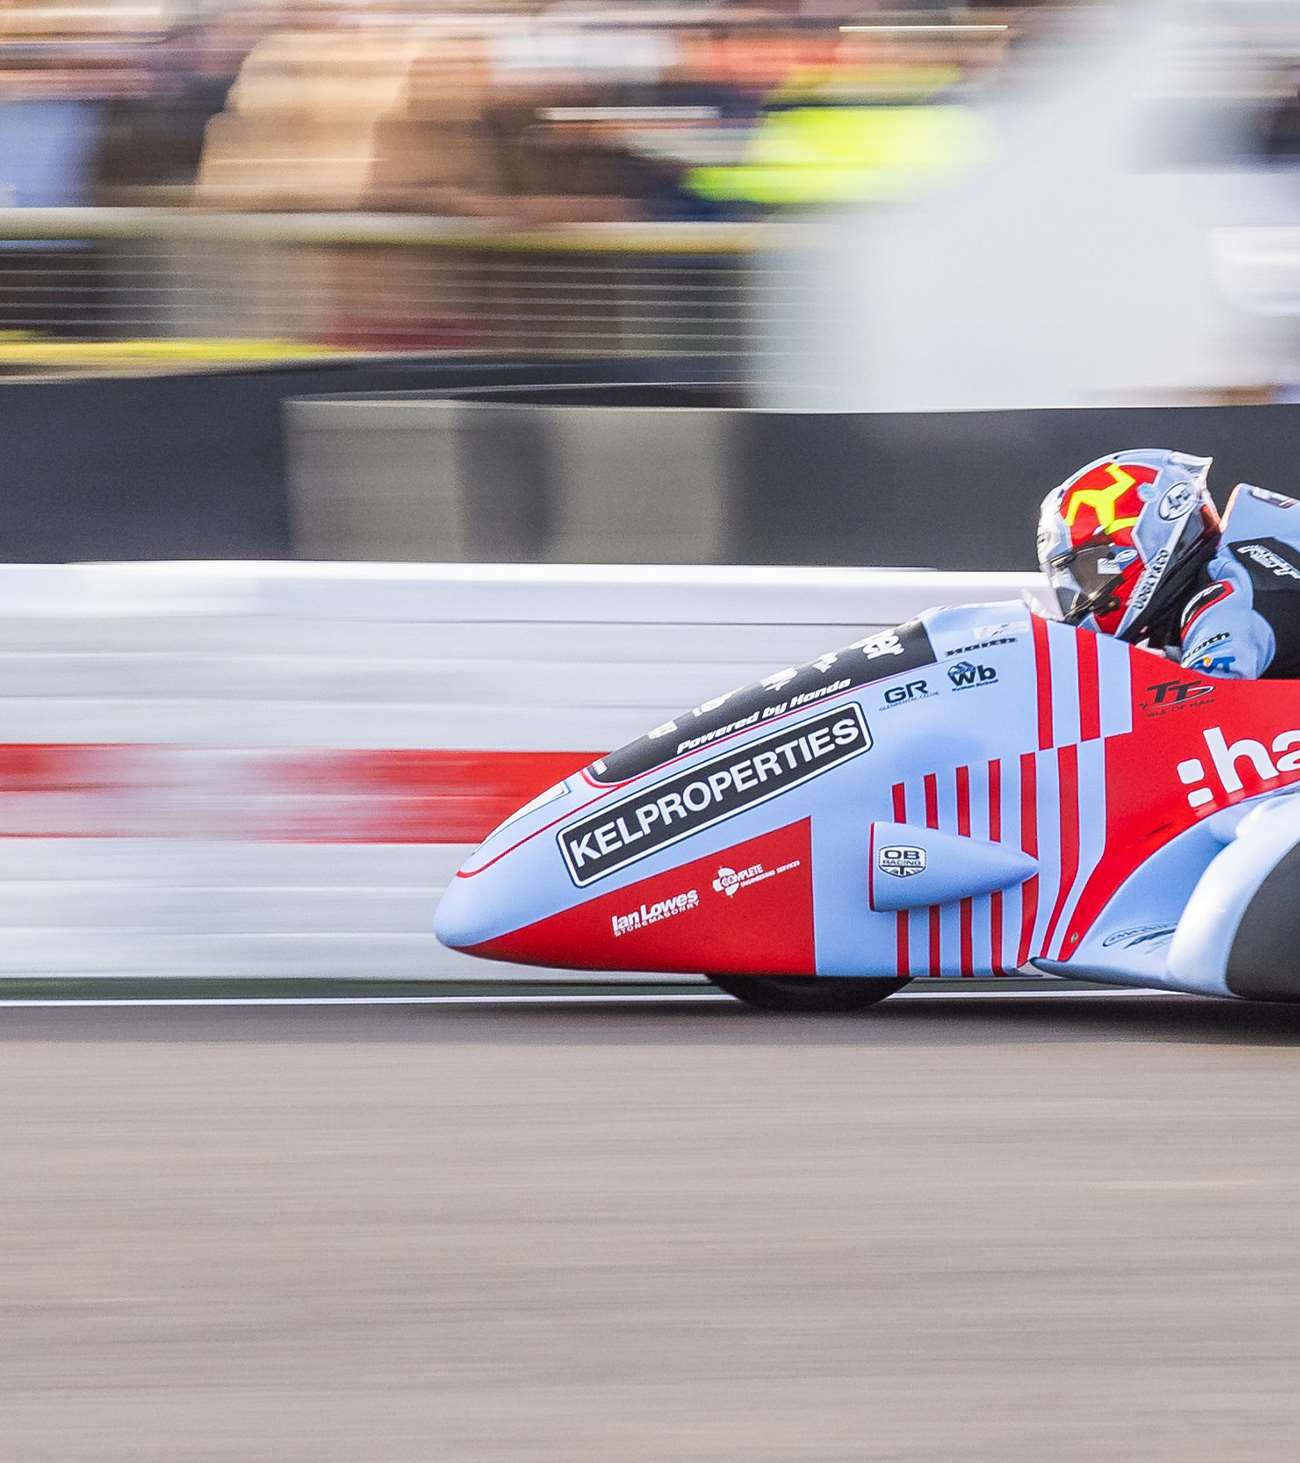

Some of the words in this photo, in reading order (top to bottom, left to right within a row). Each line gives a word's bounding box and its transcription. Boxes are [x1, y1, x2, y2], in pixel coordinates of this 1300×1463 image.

[884, 680, 929, 704] GR
[1147, 680, 1203, 704] TT
[676, 711, 760, 755] Powered
[762, 702, 788, 720] by
[790, 678, 852, 708] Honda
[569, 718, 860, 868] KELPROPERTIES
[721, 864, 764, 887] COMPLETE
[611, 911, 641, 934] Ian
[640, 889, 700, 921] Lowes
[613, 901, 701, 938] STONEMASONRY
